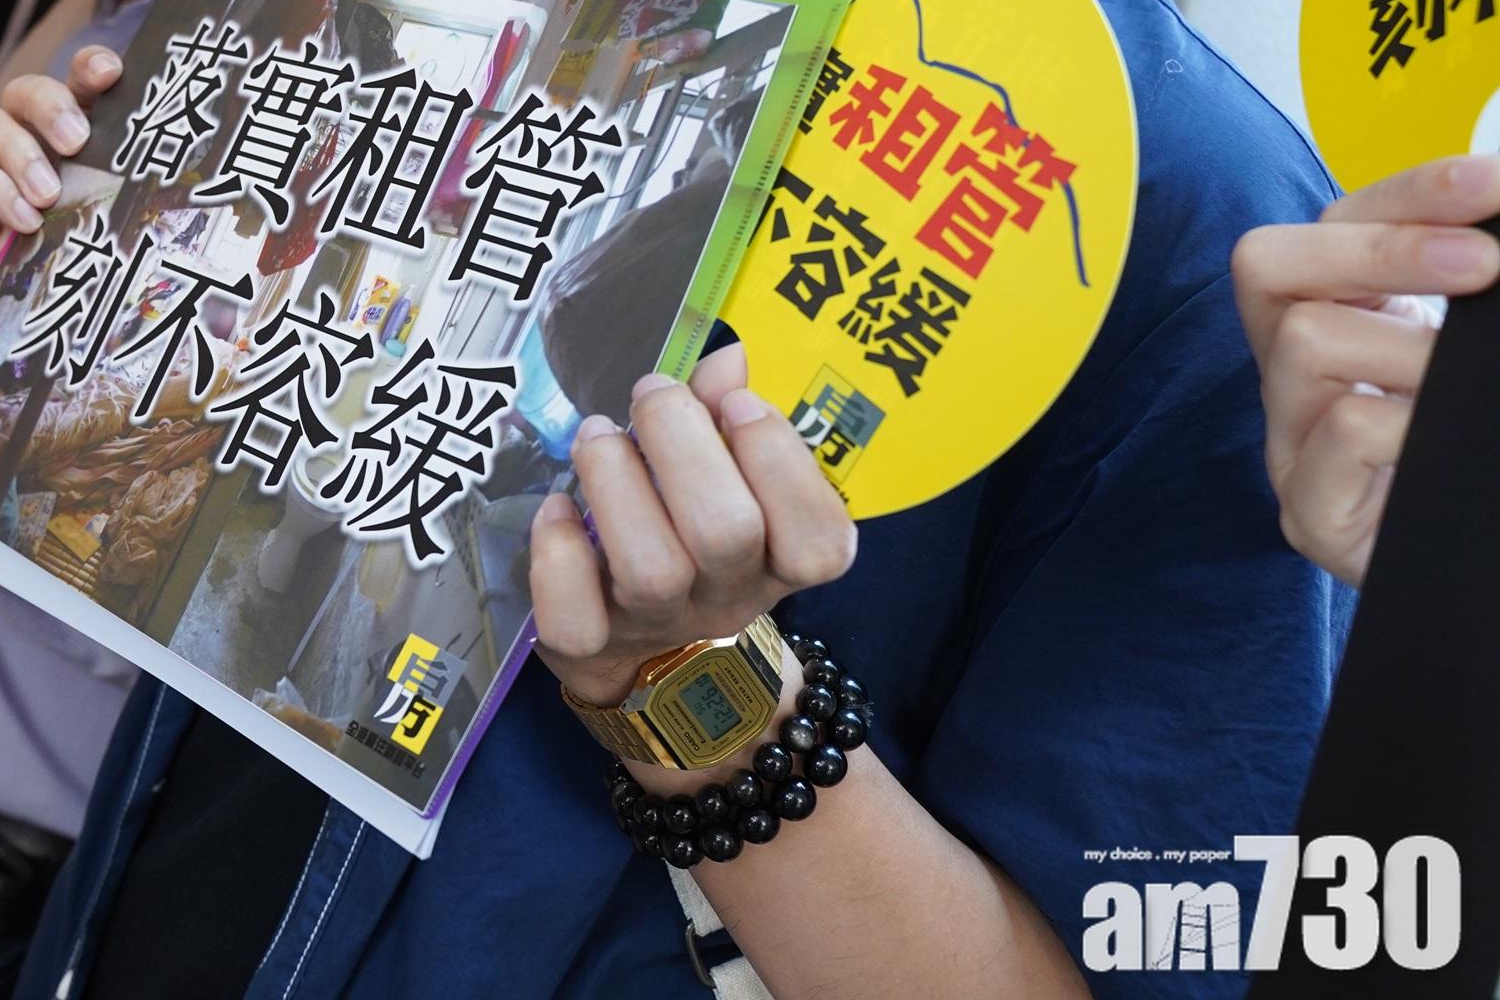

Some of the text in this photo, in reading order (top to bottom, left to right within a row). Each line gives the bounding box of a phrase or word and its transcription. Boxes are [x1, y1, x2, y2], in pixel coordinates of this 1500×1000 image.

[116, 18, 623, 301] 落實租管
[14, 217, 516, 563] 刻不容緩
[683, 731, 700, 751] CASIO
